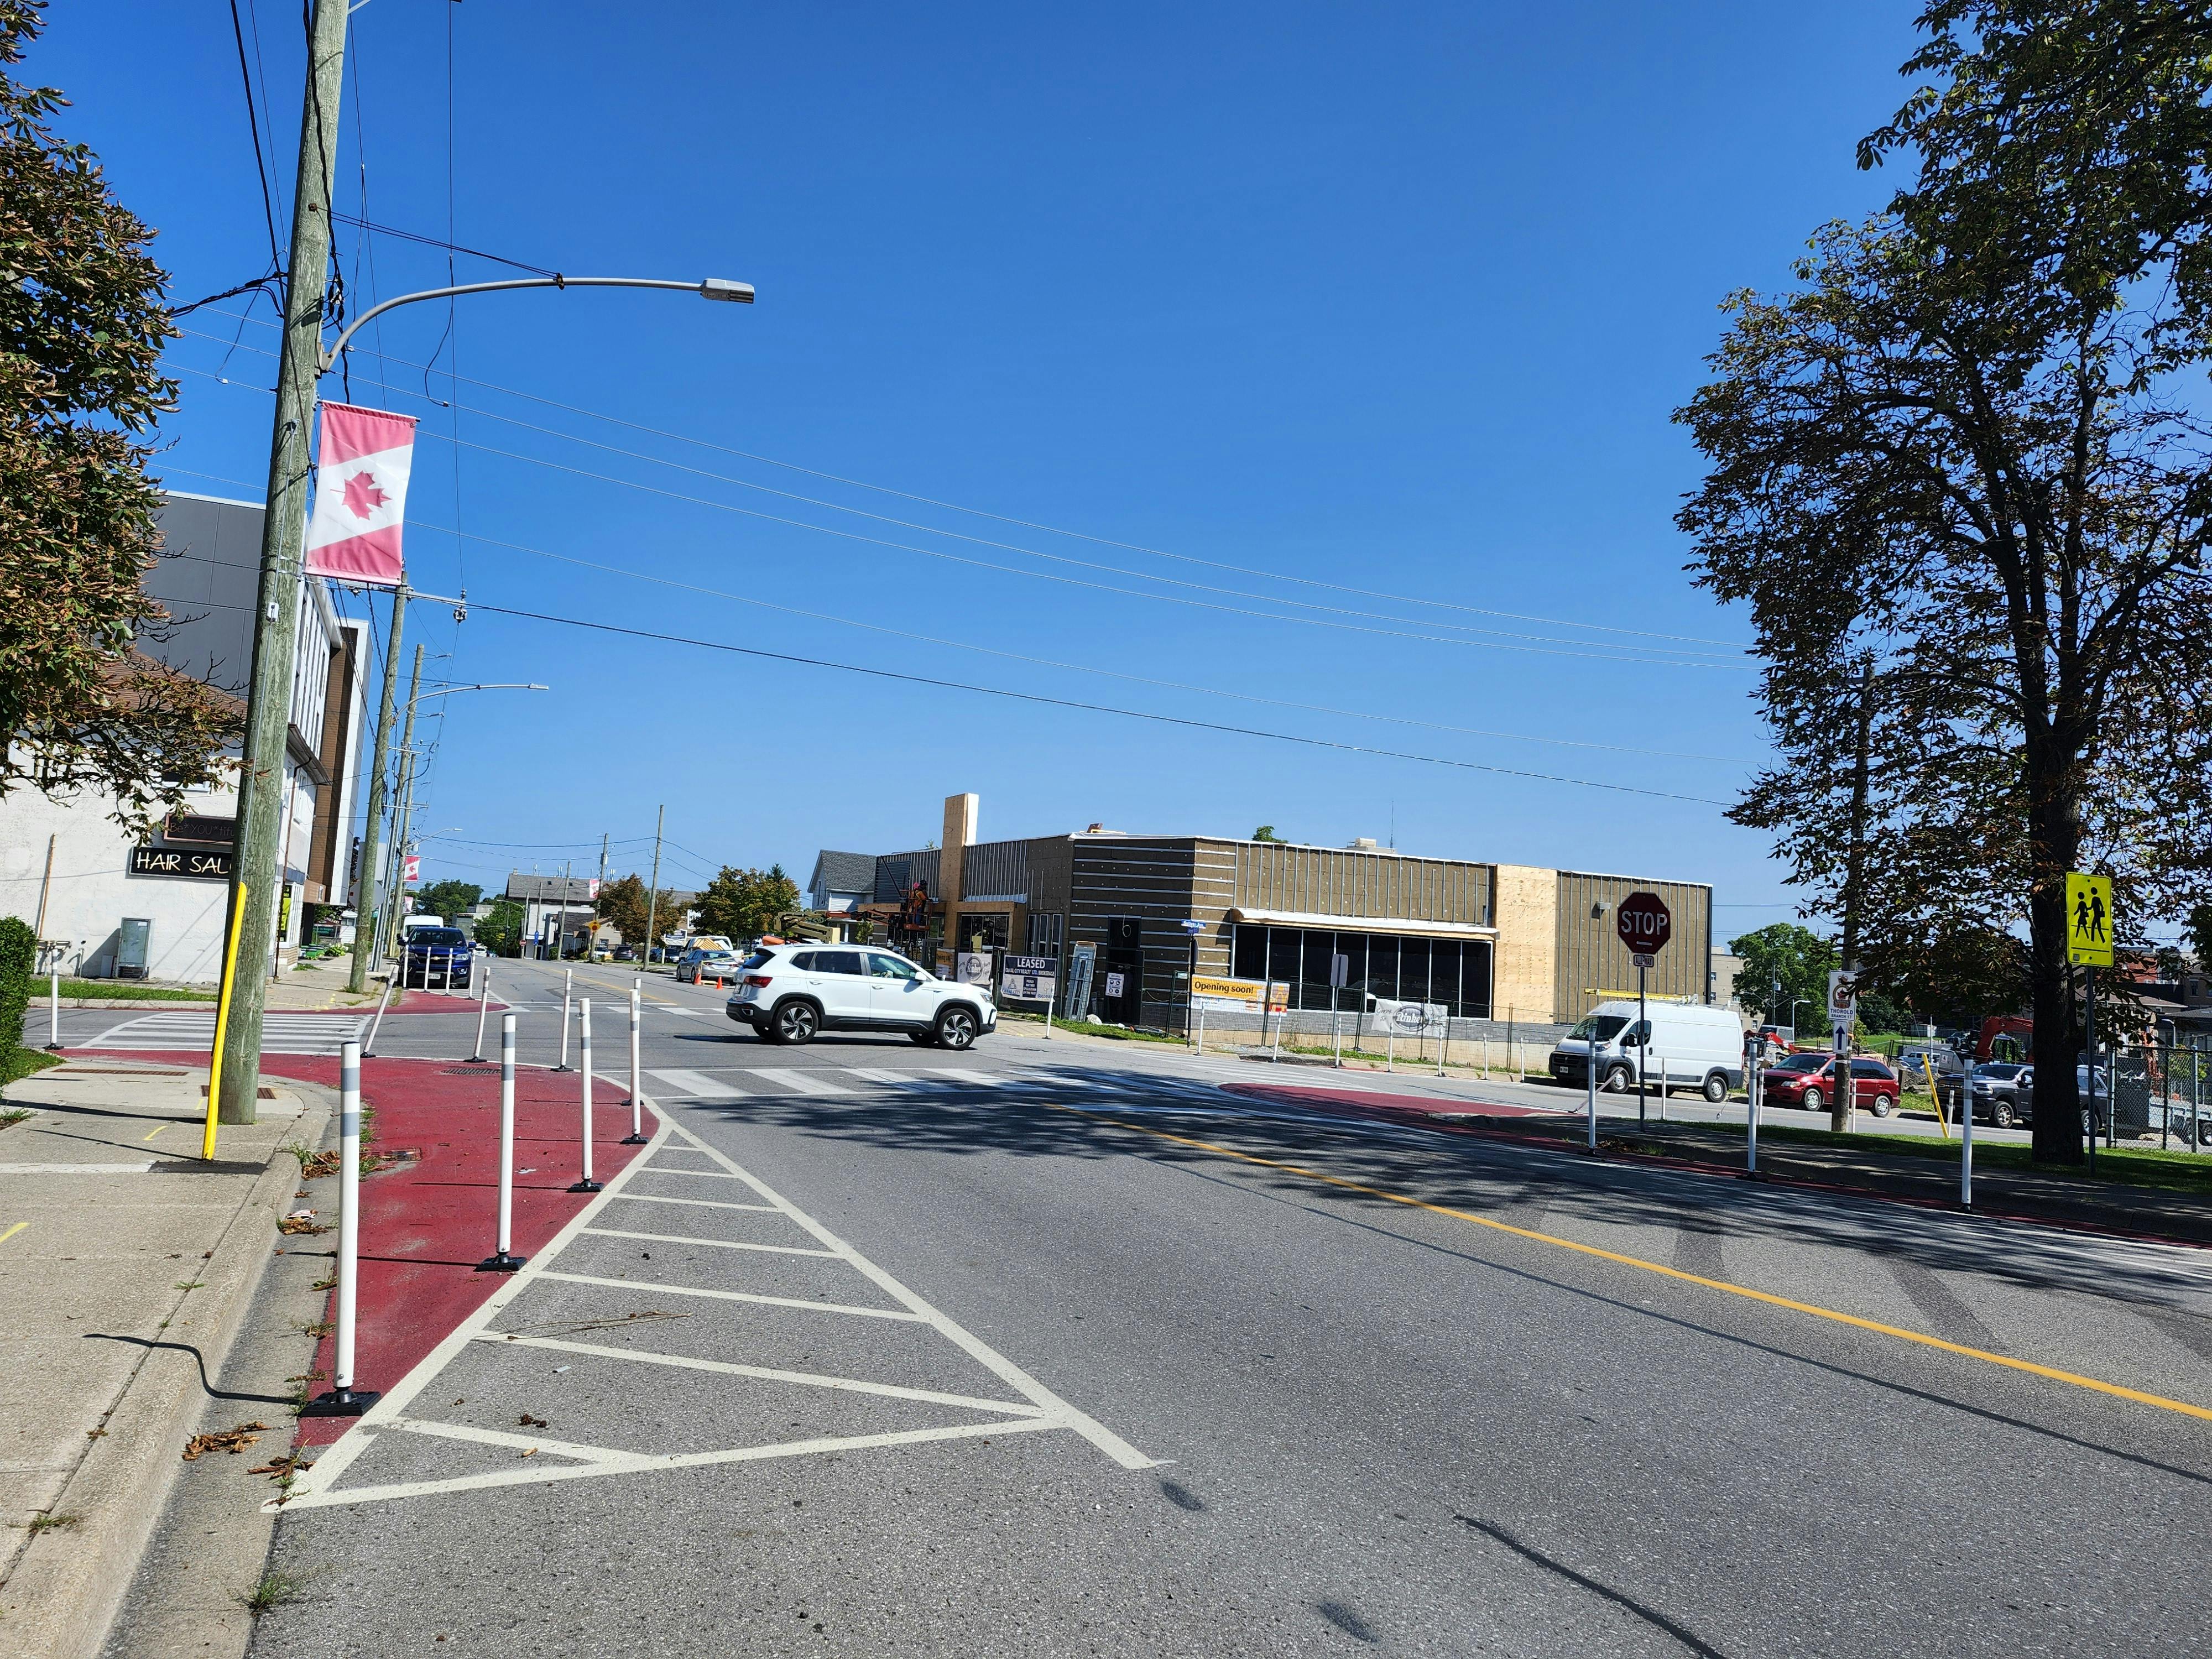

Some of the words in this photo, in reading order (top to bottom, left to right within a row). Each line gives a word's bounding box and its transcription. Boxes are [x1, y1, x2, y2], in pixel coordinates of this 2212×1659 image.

[137, 852, 181, 871] HAIR
[189, 856, 232, 874] SAL
[1621, 910, 1667, 935] STOP
[1017, 958, 1045, 969] LEASED
[1194, 981, 1230, 994] Opening
